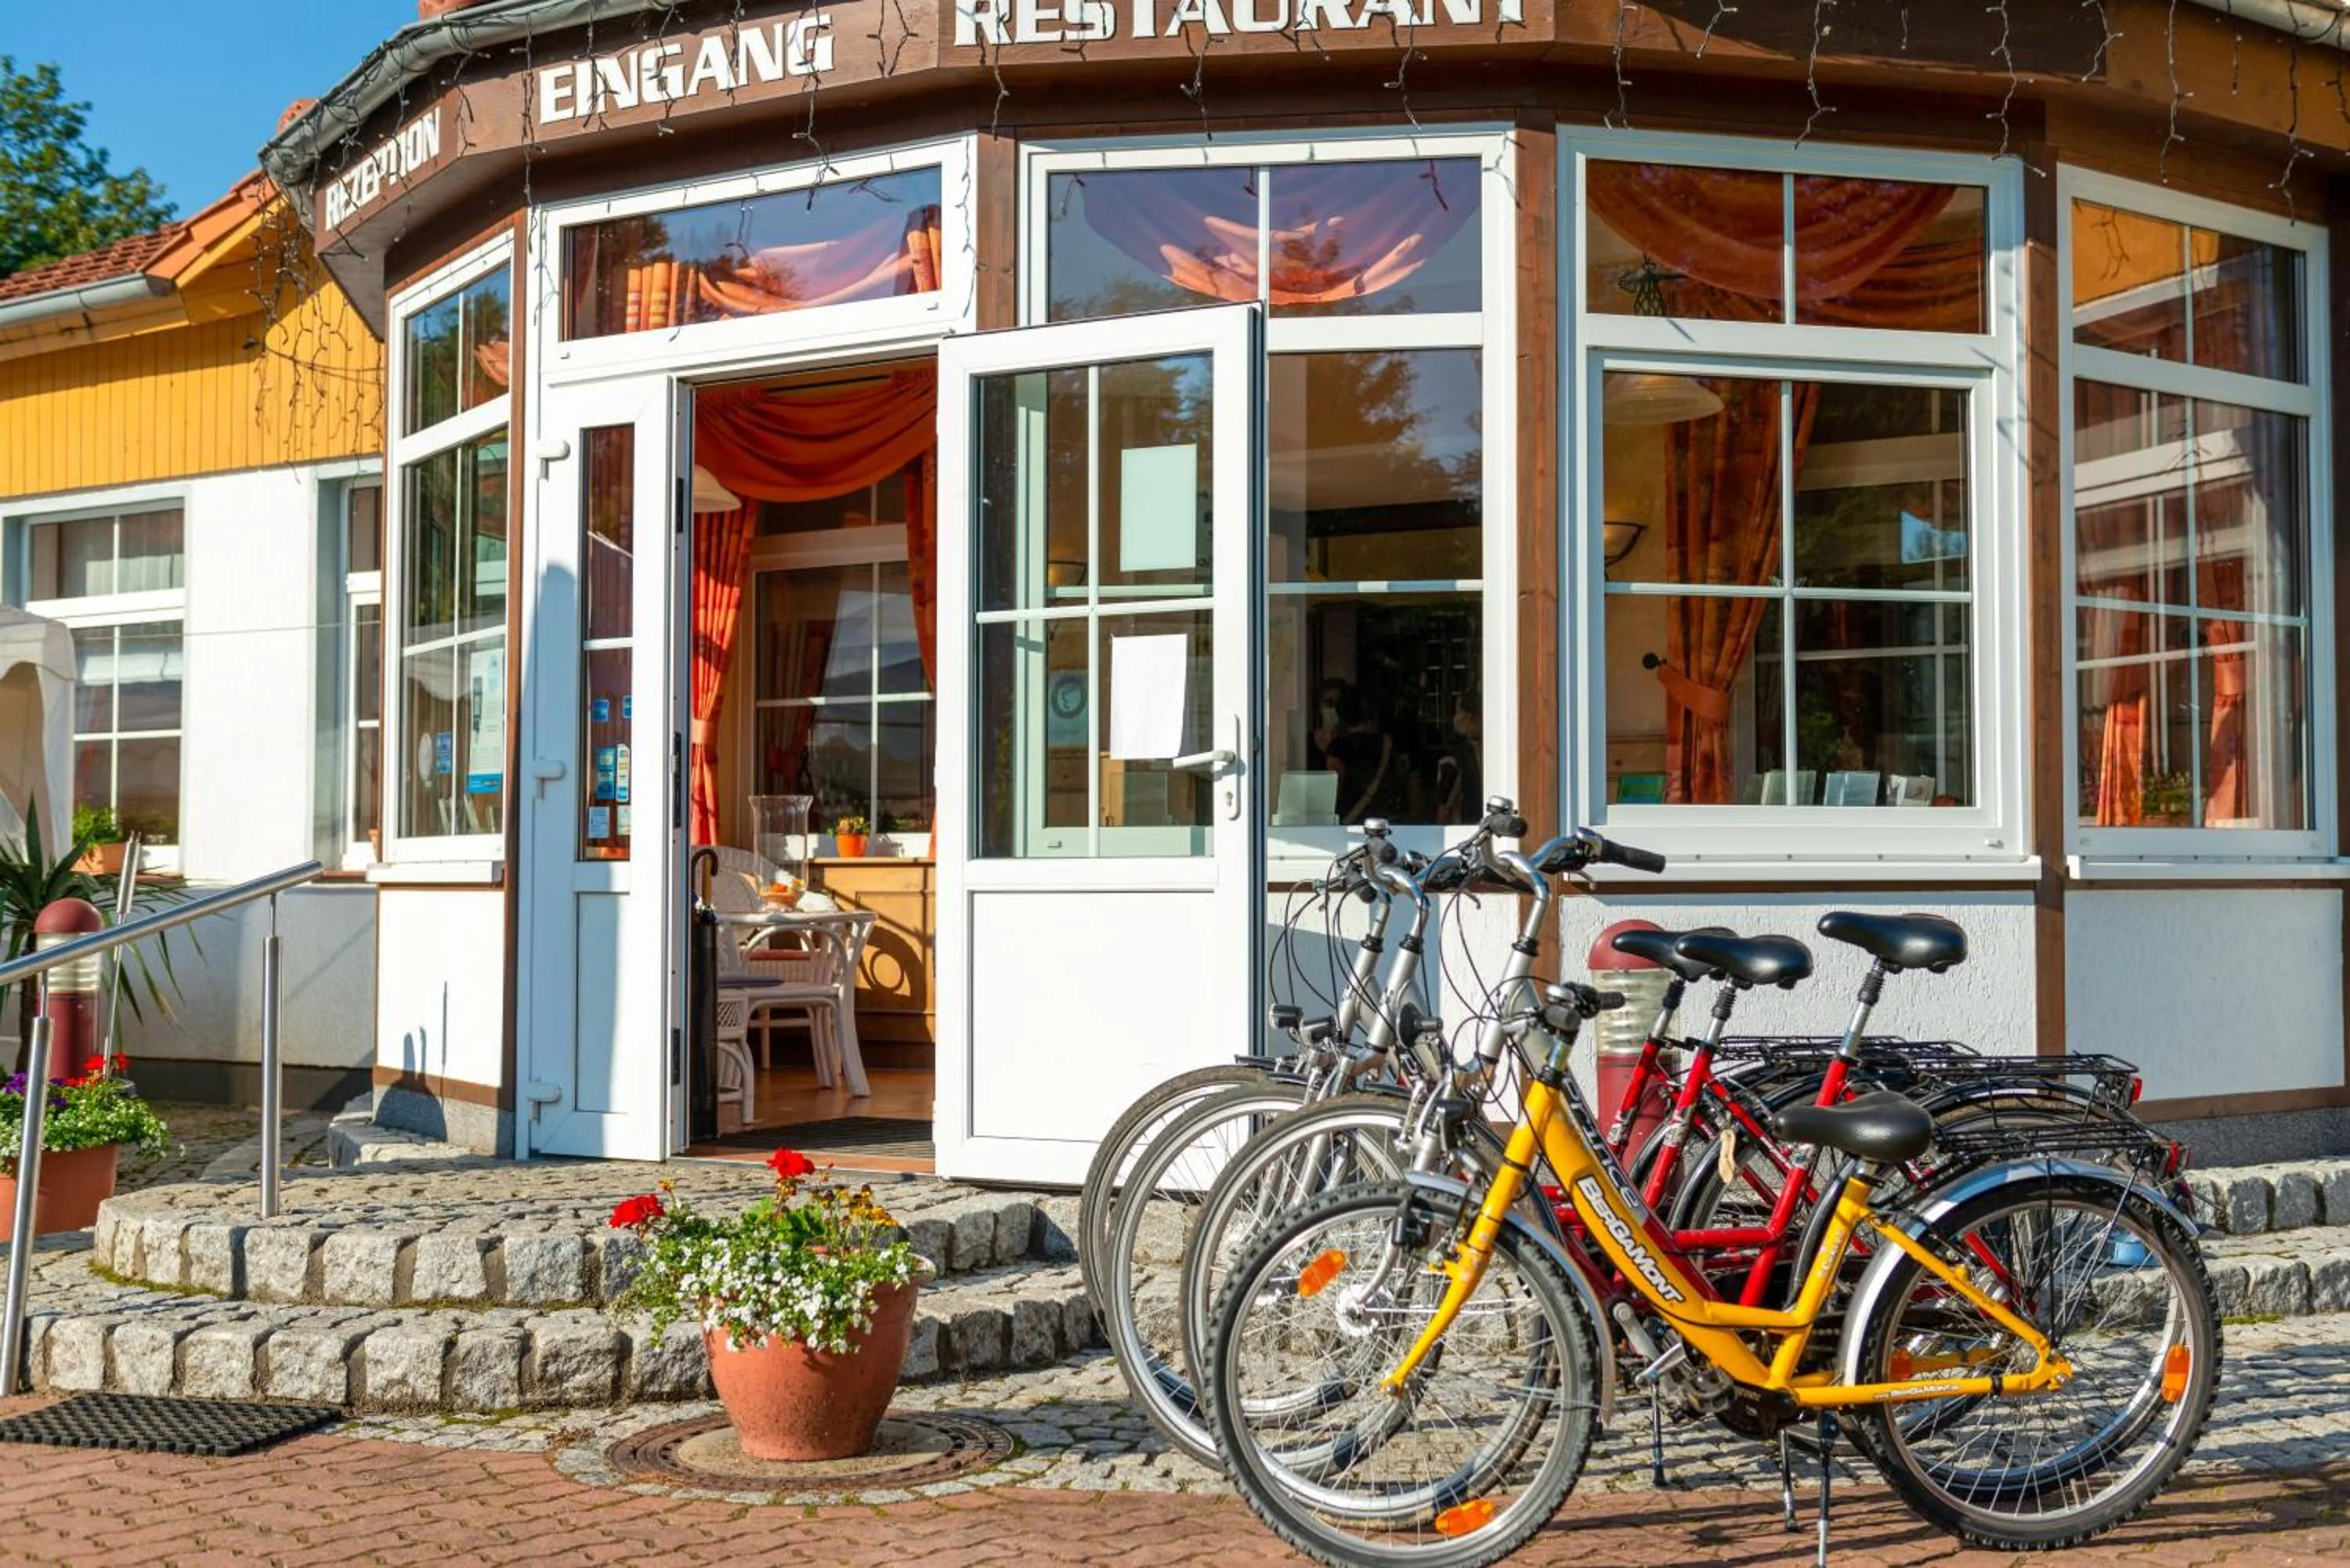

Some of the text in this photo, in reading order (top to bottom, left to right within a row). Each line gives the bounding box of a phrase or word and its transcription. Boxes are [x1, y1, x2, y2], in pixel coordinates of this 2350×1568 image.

[539, 13, 834, 124] EINGANG
[325, 107, 440, 232] REZEPTION
[1576, 1176, 1684, 1302] BERGAMONT
